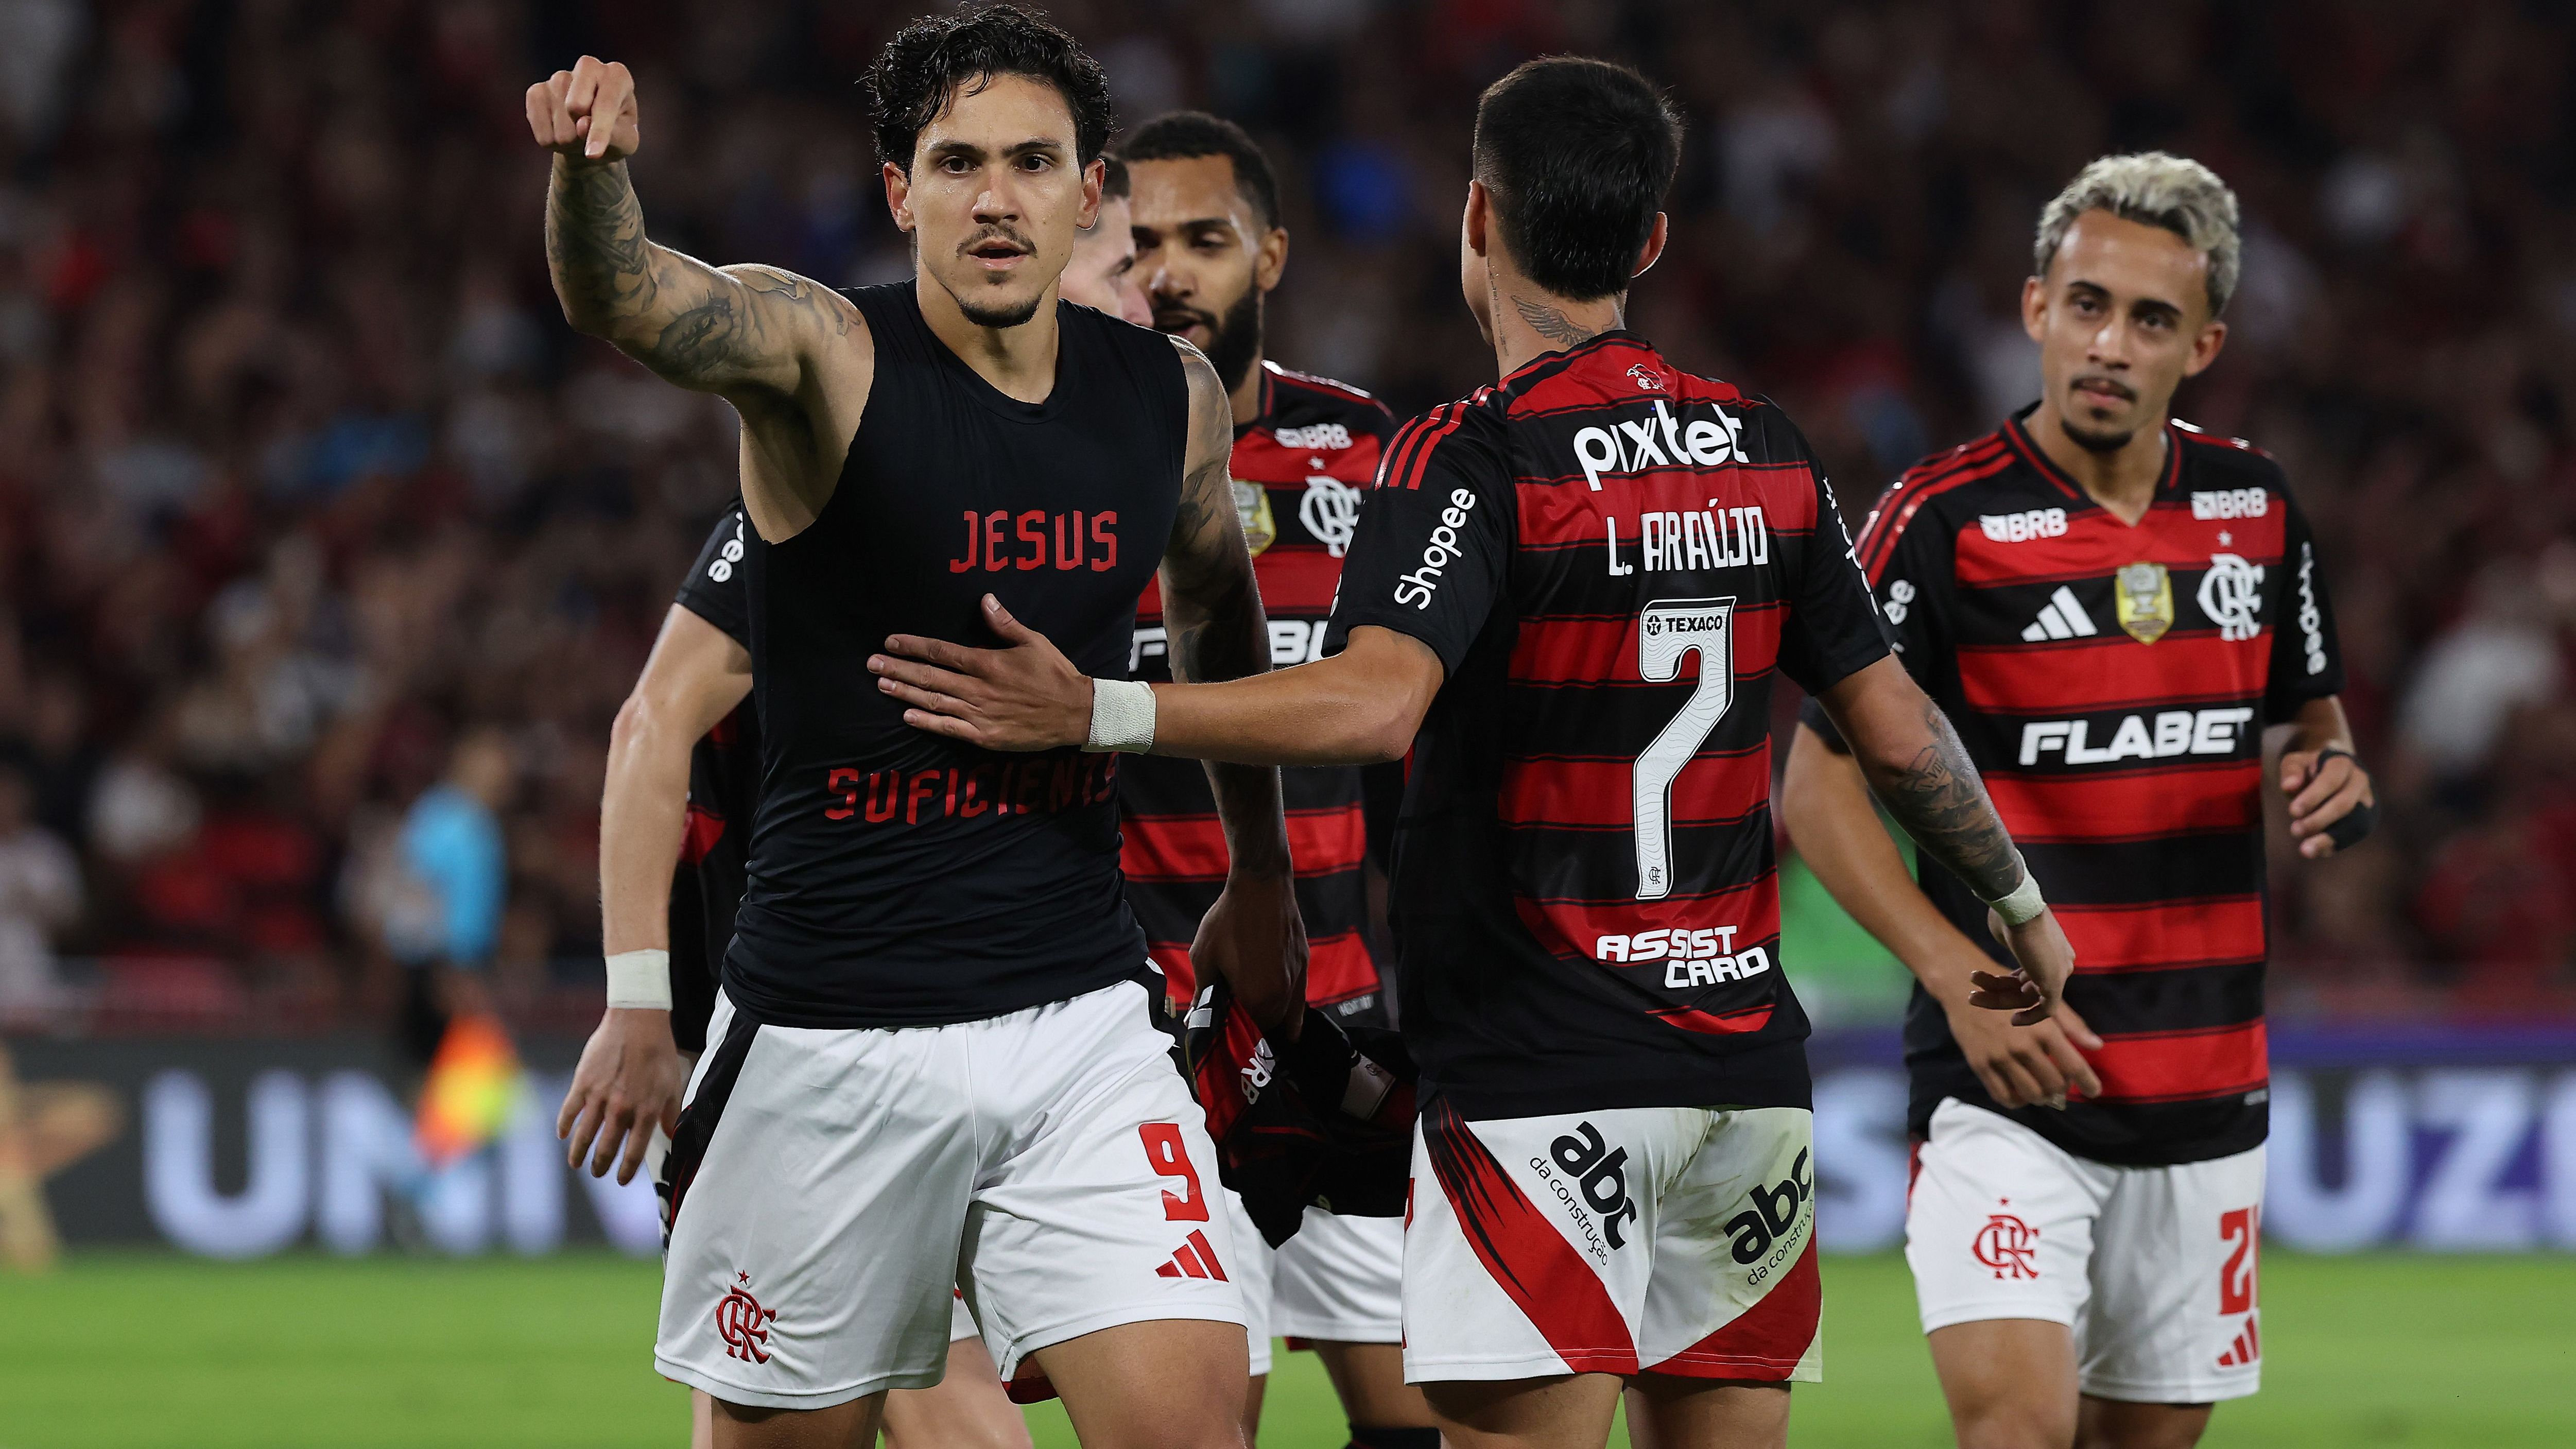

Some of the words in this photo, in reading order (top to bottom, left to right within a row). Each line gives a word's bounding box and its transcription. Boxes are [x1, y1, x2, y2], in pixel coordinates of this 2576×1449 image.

[949, 510, 1117, 573] JESUS
[1606, 516, 1633, 576] L.
[1640, 498, 1768, 571] ARAÚJO
[2008, 507, 2068, 543] BRB
[2215, 487, 2268, 520] BRB
[1394, 488, 1476, 610] Shopee
[1666, 615, 1723, 632] TEXACO
[1633, 595, 1737, 900] 7
[1597, 925, 1737, 962] ASSIST
[1665, 946, 1770, 988] CARD
[1138, 1123, 1209, 1222] 9
[1530, 1157, 1551, 1180] da
[1550, 1179, 1607, 1266] construção
[1550, 1120, 1636, 1250] abc
[1724, 1145, 1811, 1265] abc
[1748, 1265, 1768, 1286] da
[1769, 1198, 1813, 1268] constr
[2219, 1204, 2260, 1315] 2
